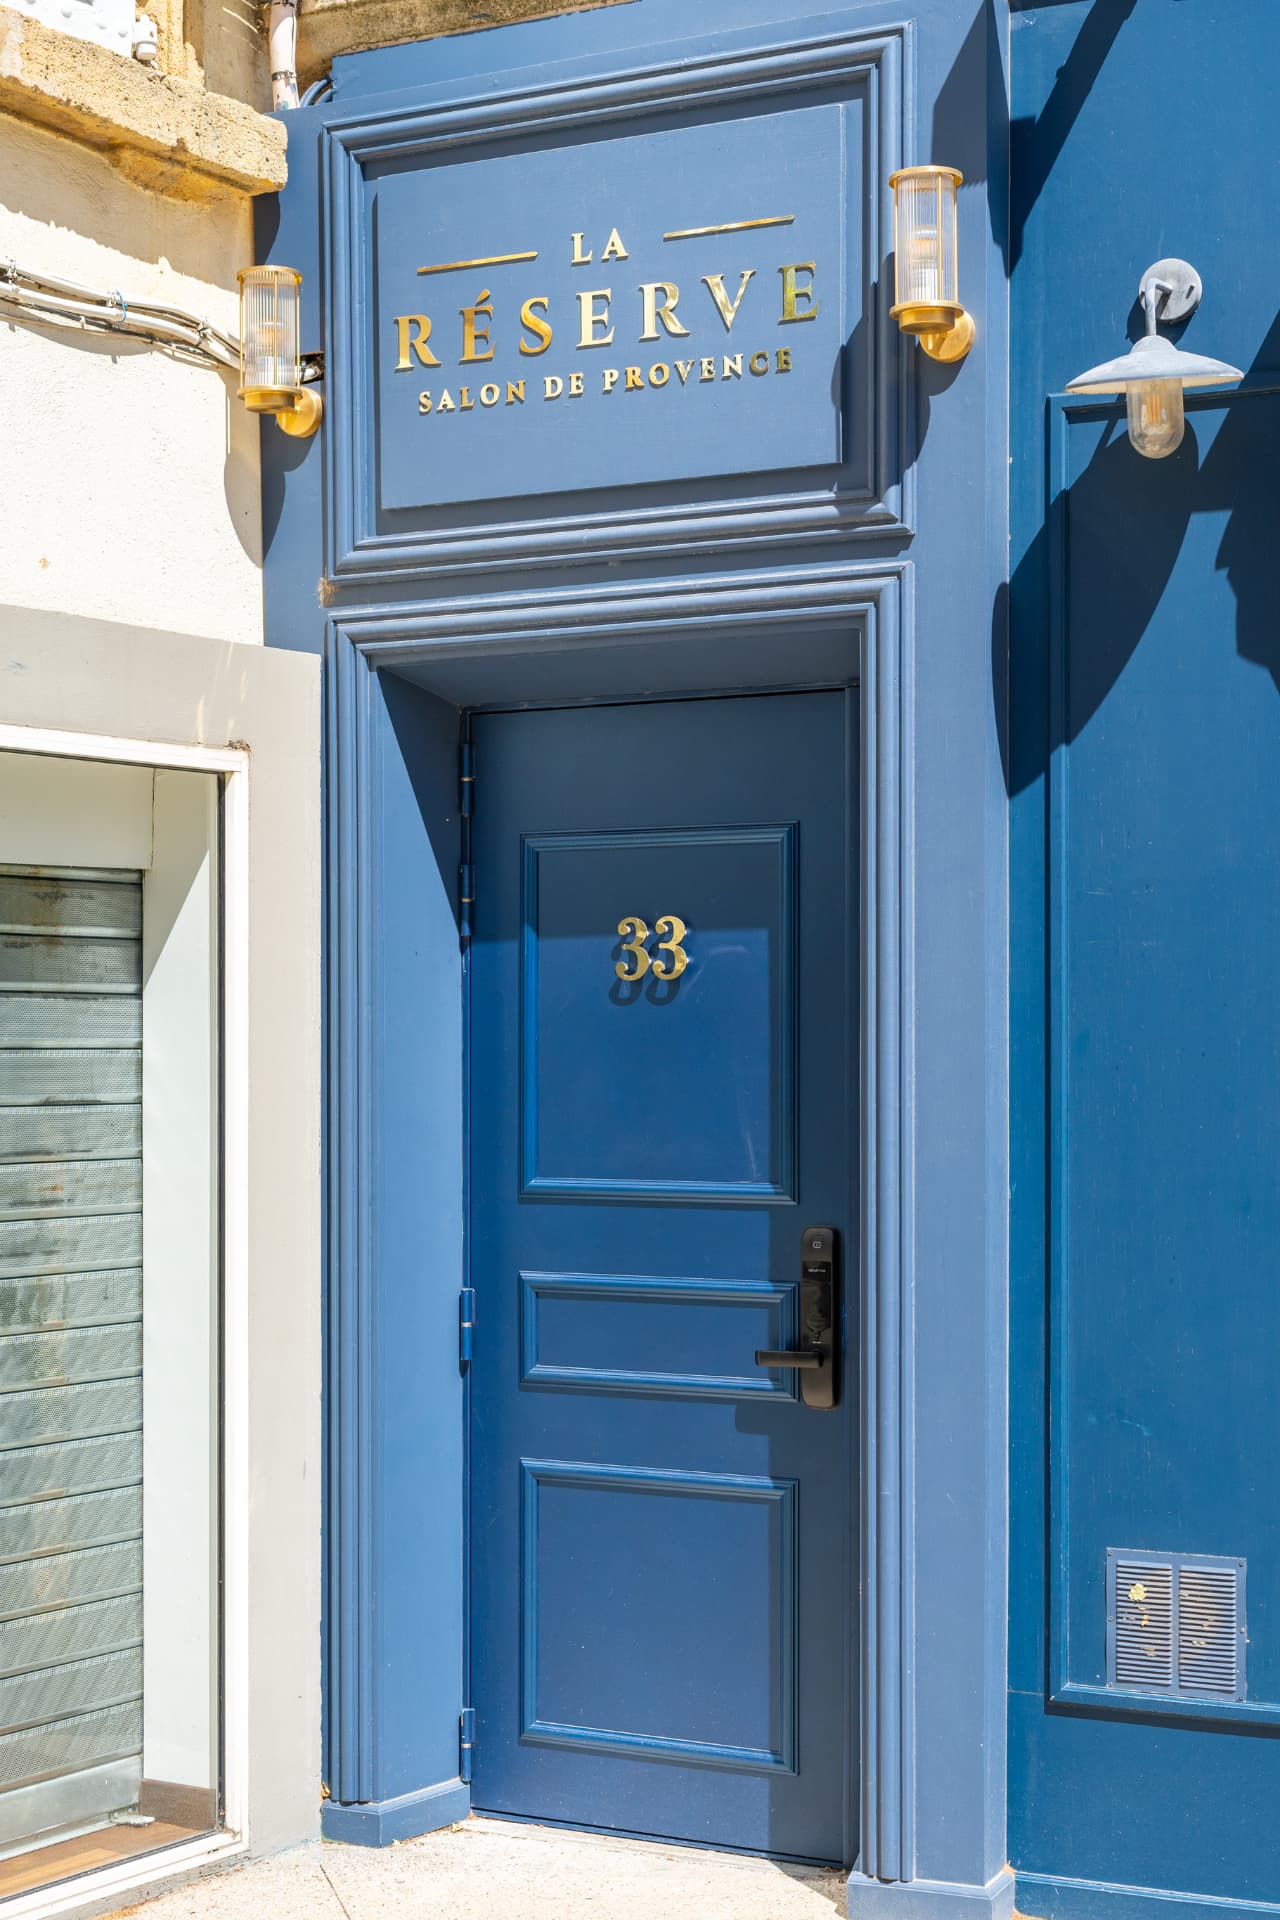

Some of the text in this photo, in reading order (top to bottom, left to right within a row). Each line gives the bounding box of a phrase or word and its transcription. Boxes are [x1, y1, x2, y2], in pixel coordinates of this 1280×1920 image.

[571, 228, 629, 266] LA
[393, 261, 819, 373] RÉSERVE
[418, 347, 793, 416] SALON DE PROVENCE
[615, 915, 689, 981] 33
